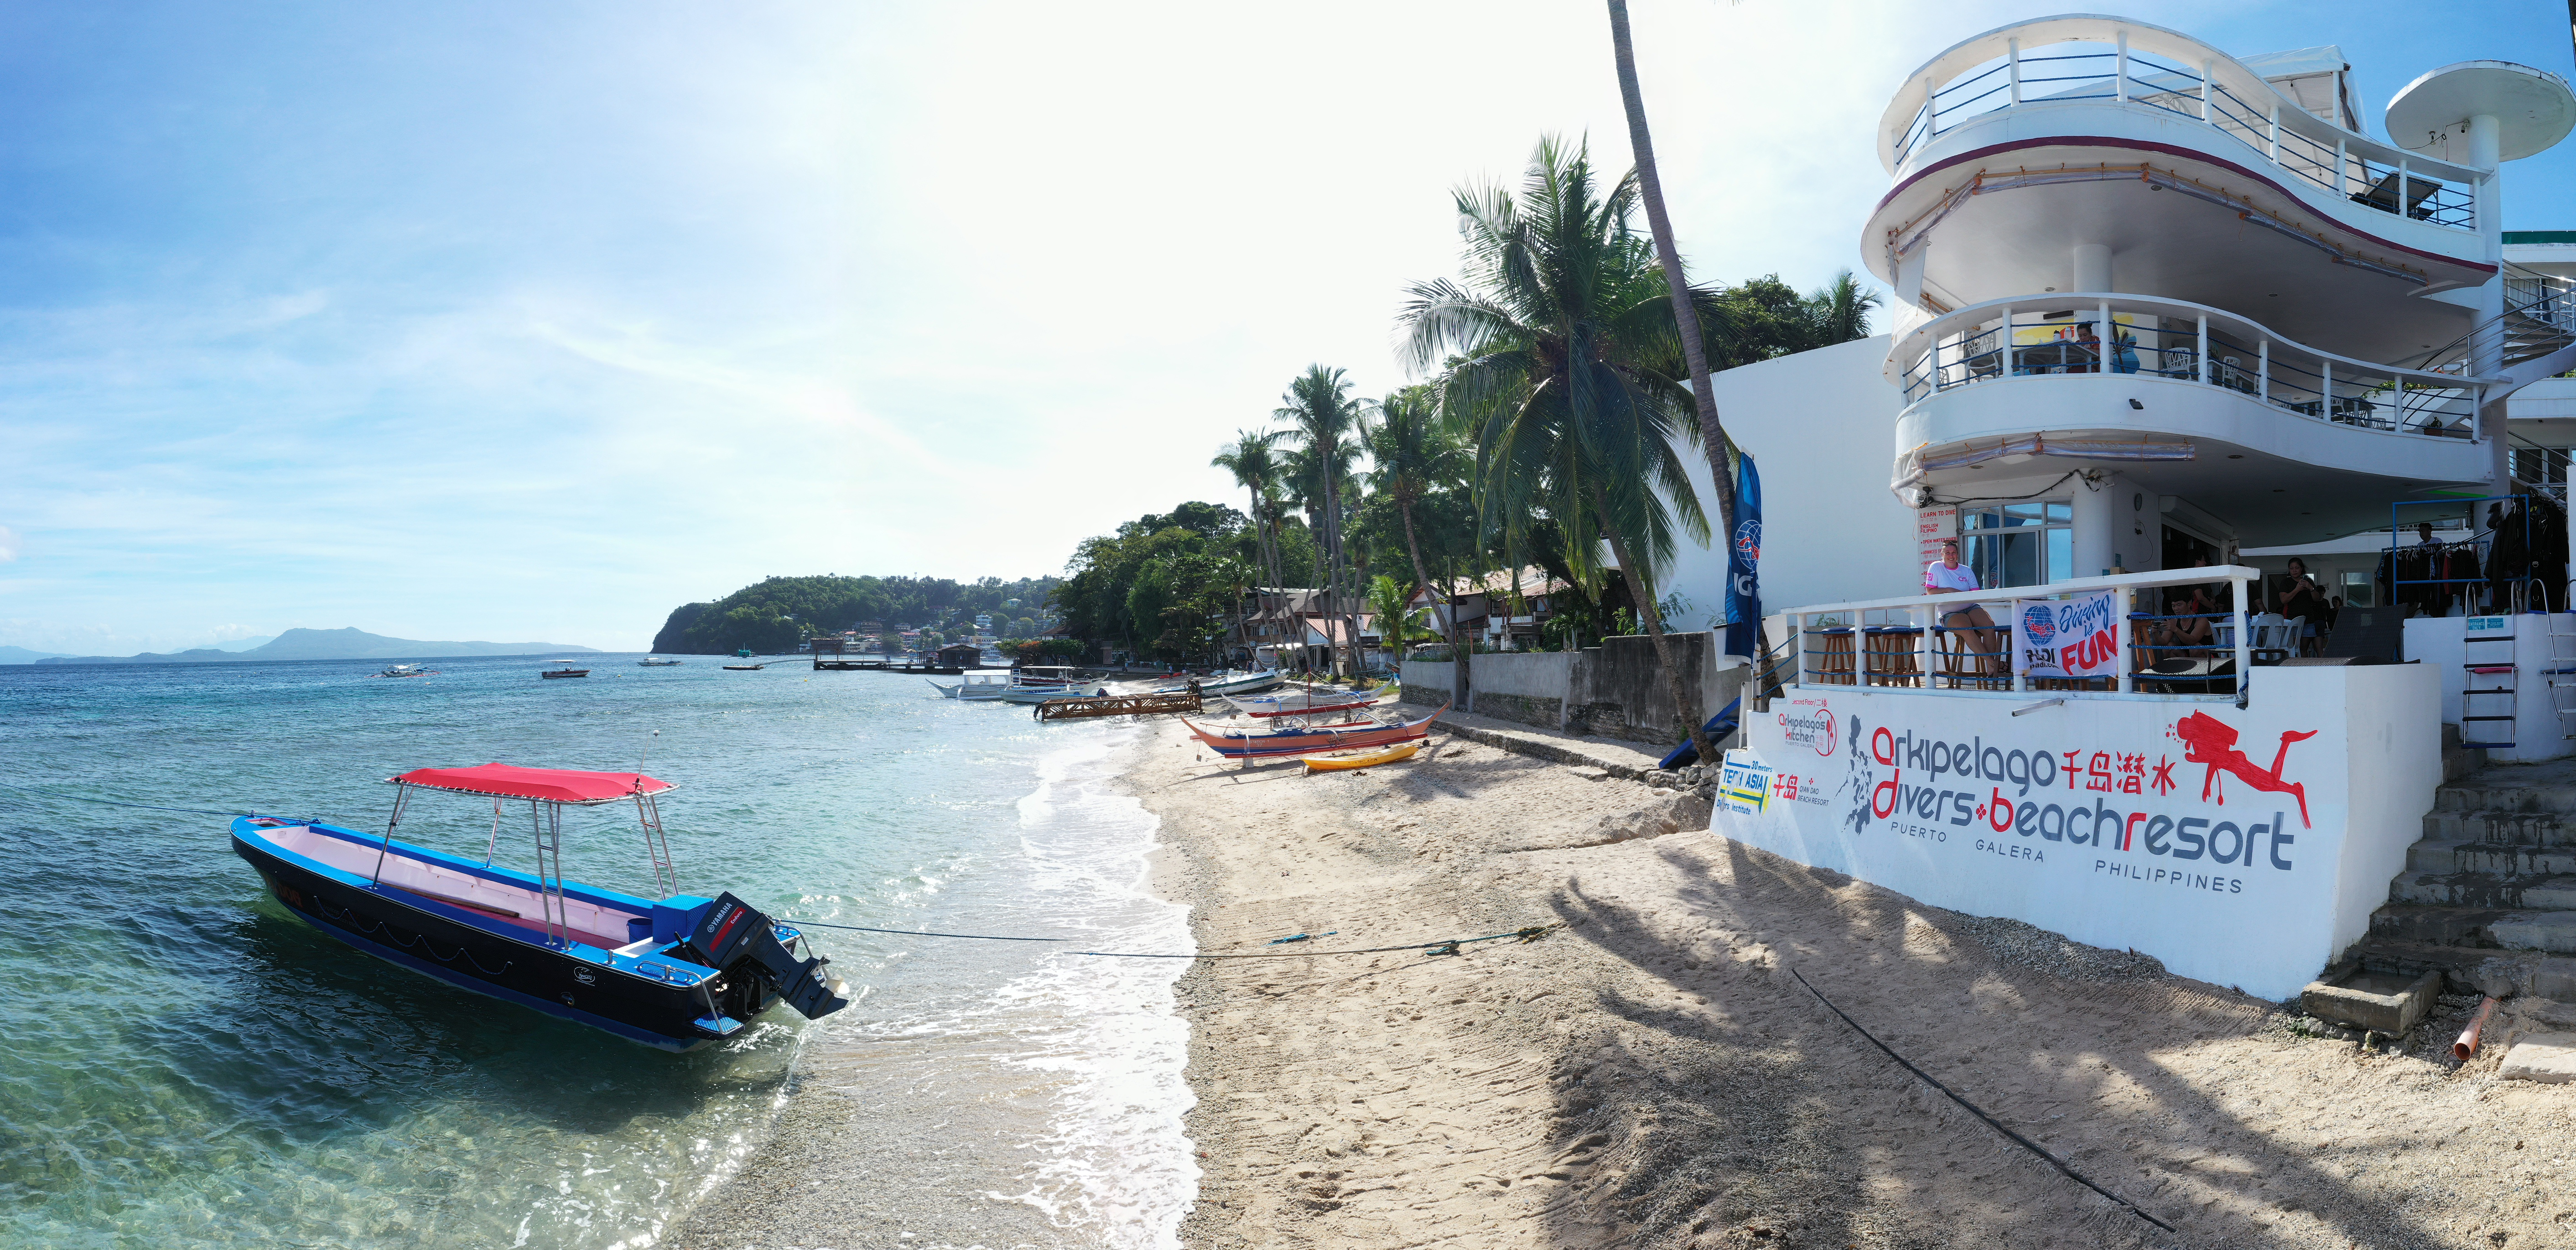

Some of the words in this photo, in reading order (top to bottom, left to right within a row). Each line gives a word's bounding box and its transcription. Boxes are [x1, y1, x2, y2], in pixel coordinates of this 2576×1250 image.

[2059, 594, 2111, 633] Diving
[2084, 620, 2095, 637] is
[2025, 648, 2056, 664] PADI
[2061, 624, 2118, 676] FUN
[1751, 760, 1758, 770] 30
[2061, 749, 2176, 796] 千岛潜水
[1745, 773, 1764, 790] ASIA
[1773, 773, 1798, 801] 千岛
[1717, 799, 1729, 810] Diers
[1731, 803, 1751, 815] Institute
[1812, 798, 1829, 807] RESORT
[1891, 822, 1946, 842] PUERTO
[1976, 839, 2044, 863] GALERA
[2095, 860, 2242, 893] PHILIPPINES
[711, 902, 732, 926] YAMAHA
[730, 911, 743, 924] Enduro
